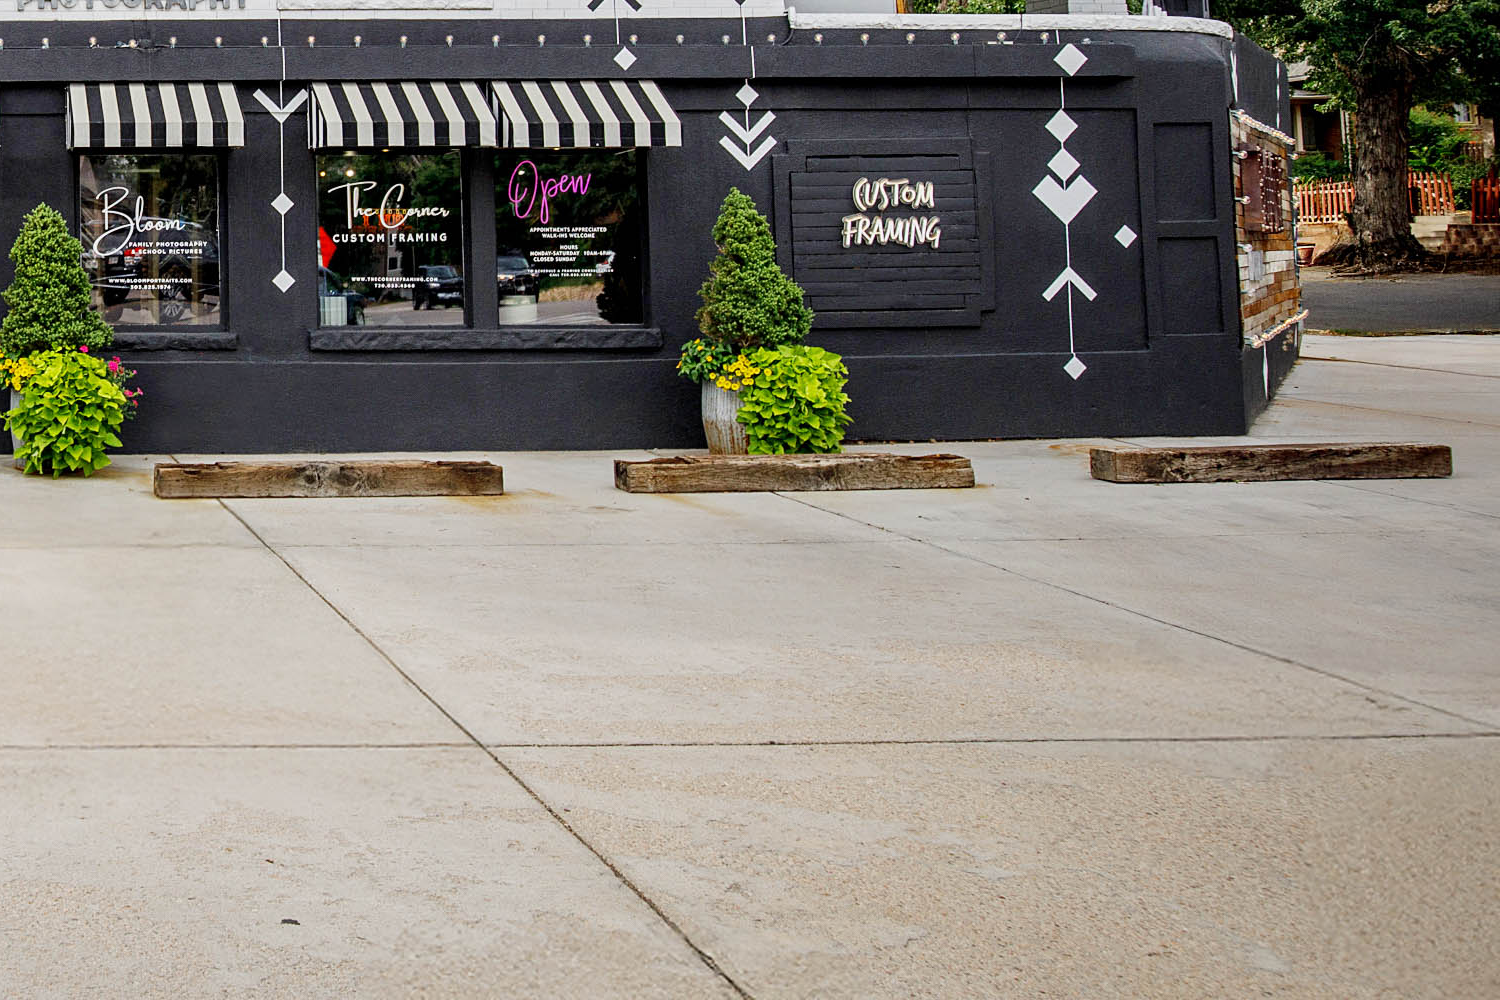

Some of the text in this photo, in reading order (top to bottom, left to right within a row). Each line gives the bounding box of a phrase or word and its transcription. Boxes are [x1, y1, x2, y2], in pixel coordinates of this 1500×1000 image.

[327, 181, 450, 229] The Corner
[508, 160, 592, 224] Open
[852, 177, 935, 212] CUSTOM
[93, 186, 186, 256] Bloom
[332, 232, 447, 243] CUSTOM FRAMING
[841, 212, 941, 249] FRAMING
